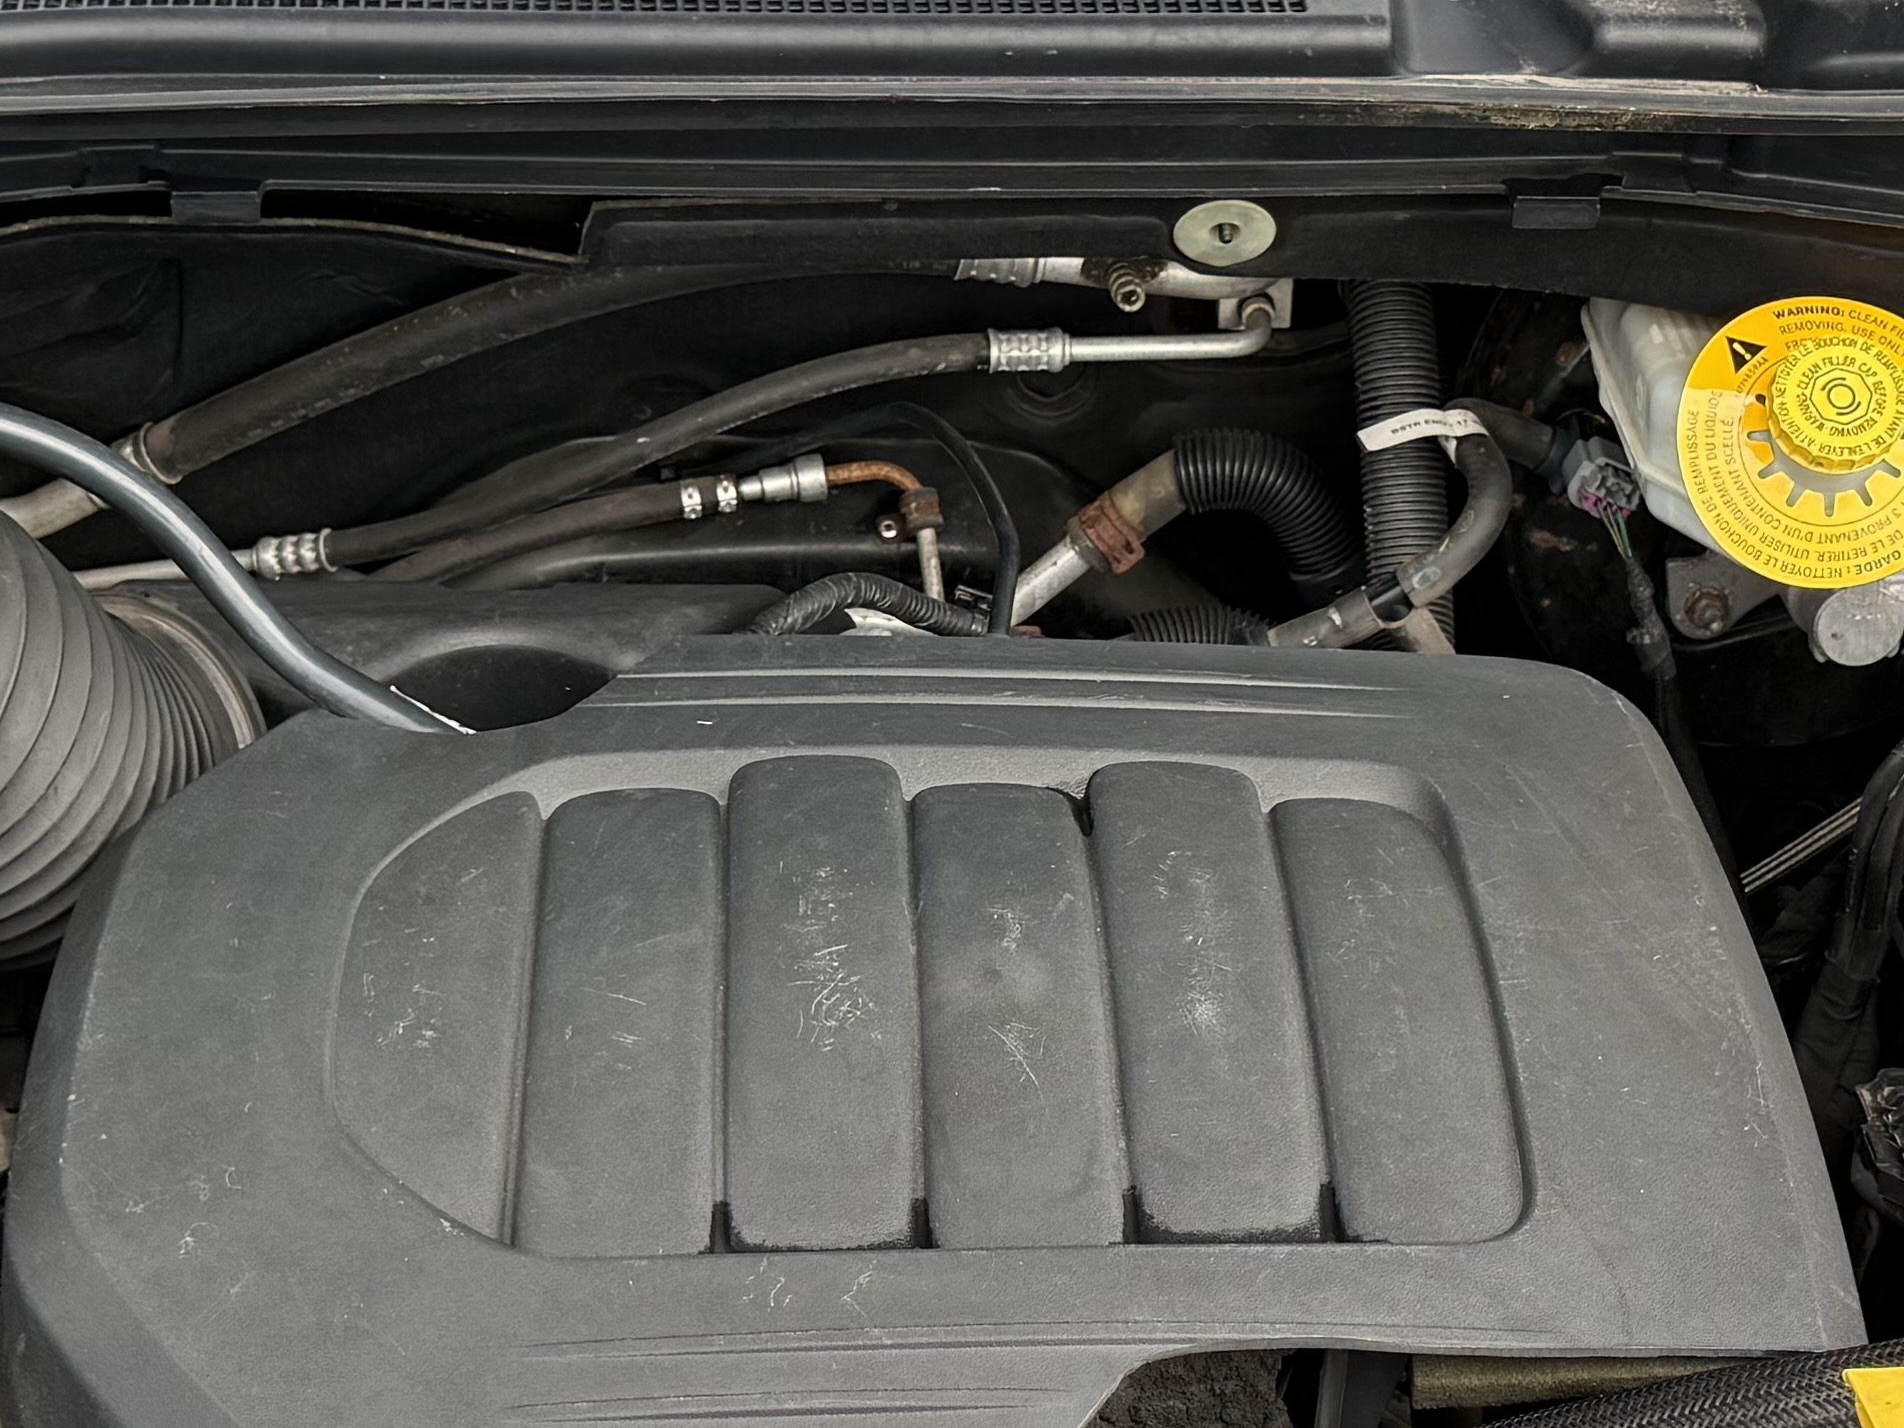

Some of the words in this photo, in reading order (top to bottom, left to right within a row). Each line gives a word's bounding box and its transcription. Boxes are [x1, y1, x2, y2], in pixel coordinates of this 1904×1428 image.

[1773, 305, 1844, 320] WARNING:
[1848, 309, 1889, 331] CLEAN
[1851, 326, 1876, 342] USE
[1703, 391, 1723, 437] LIQUIDE
[1686, 409, 1707, 496] REMPLISSAGE
[1705, 443, 1718, 462] DU
[1701, 495, 1718, 512] DE
[1712, 465, 1761, 536] UNIQUEMENT
[1728, 468, 1782, 530] CONTENANT
[1891, 508, 1902, 517] 3
[1714, 513, 1763, 561] BOUCHON
[1817, 514, 1892, 545] PROVENANT
[1889, 528, 1904, 546] DE
[1760, 531, 1810, 560] UTILISER
[1871, 538, 1886, 554] LE
[1763, 555, 1778, 569] LE
[1780, 563, 1842, 579] NETTOYER
[1855, 550, 1902, 575] GARDE
